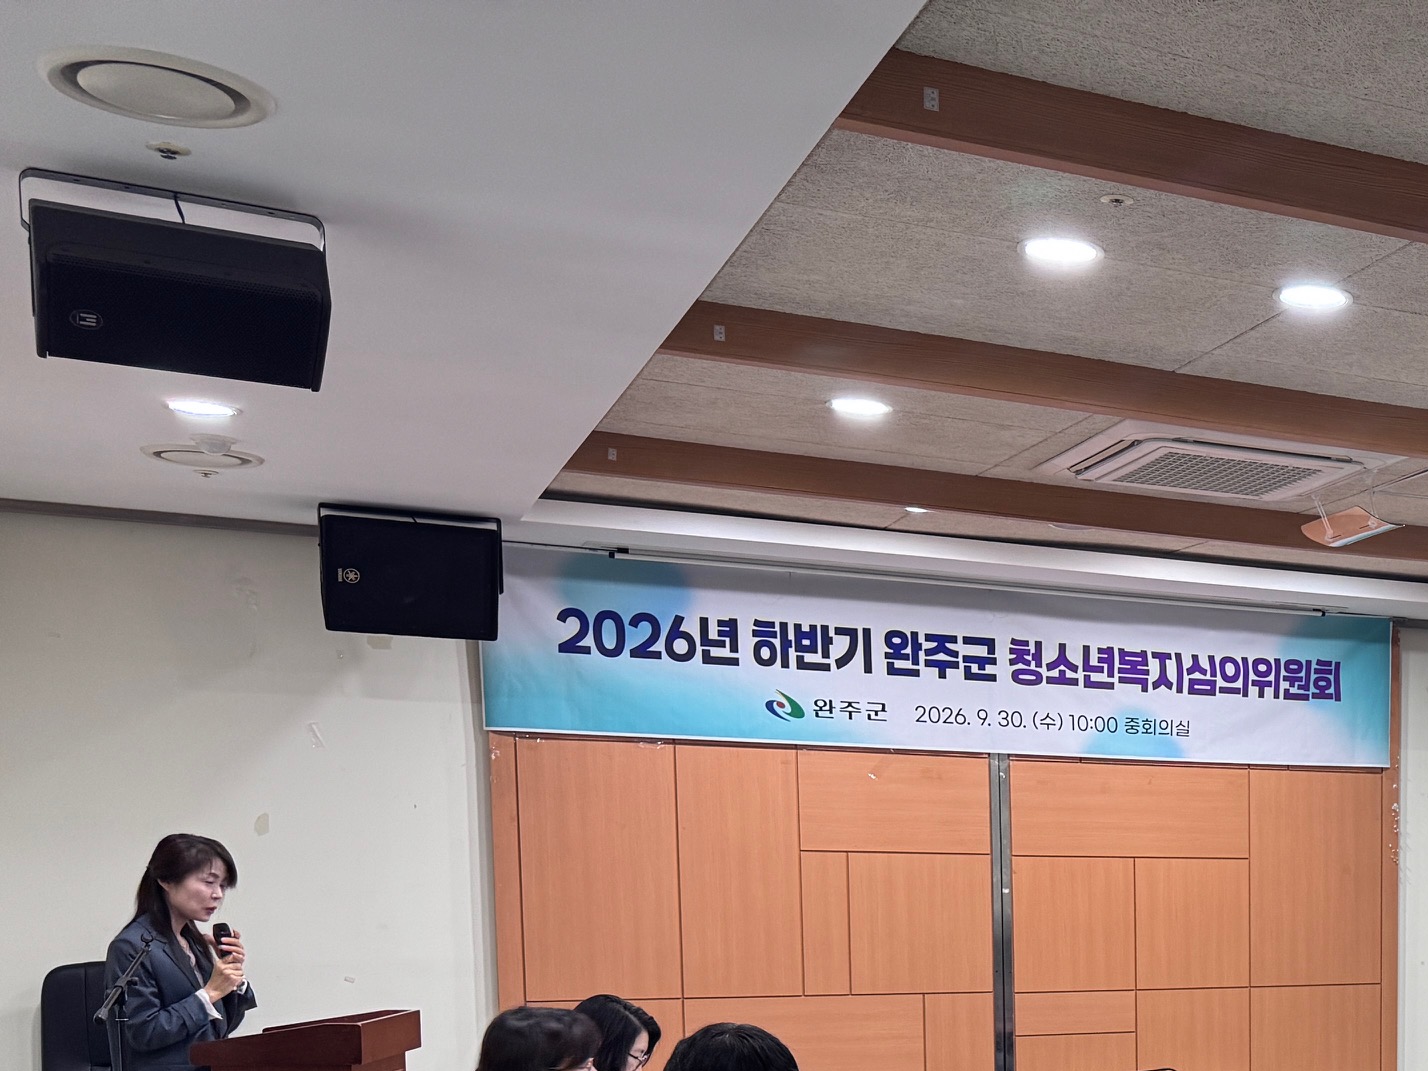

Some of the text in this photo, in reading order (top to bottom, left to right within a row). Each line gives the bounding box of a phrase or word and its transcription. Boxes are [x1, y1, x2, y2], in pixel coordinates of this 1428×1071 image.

[556, 607, 1342, 702] 2026년 하반기 완주군 청소년복지심의위원회
[812, 698, 888, 722] 완주군
[914, 705, 1191, 738] 2026. 9. 30. (수) 10:00 중회의실
